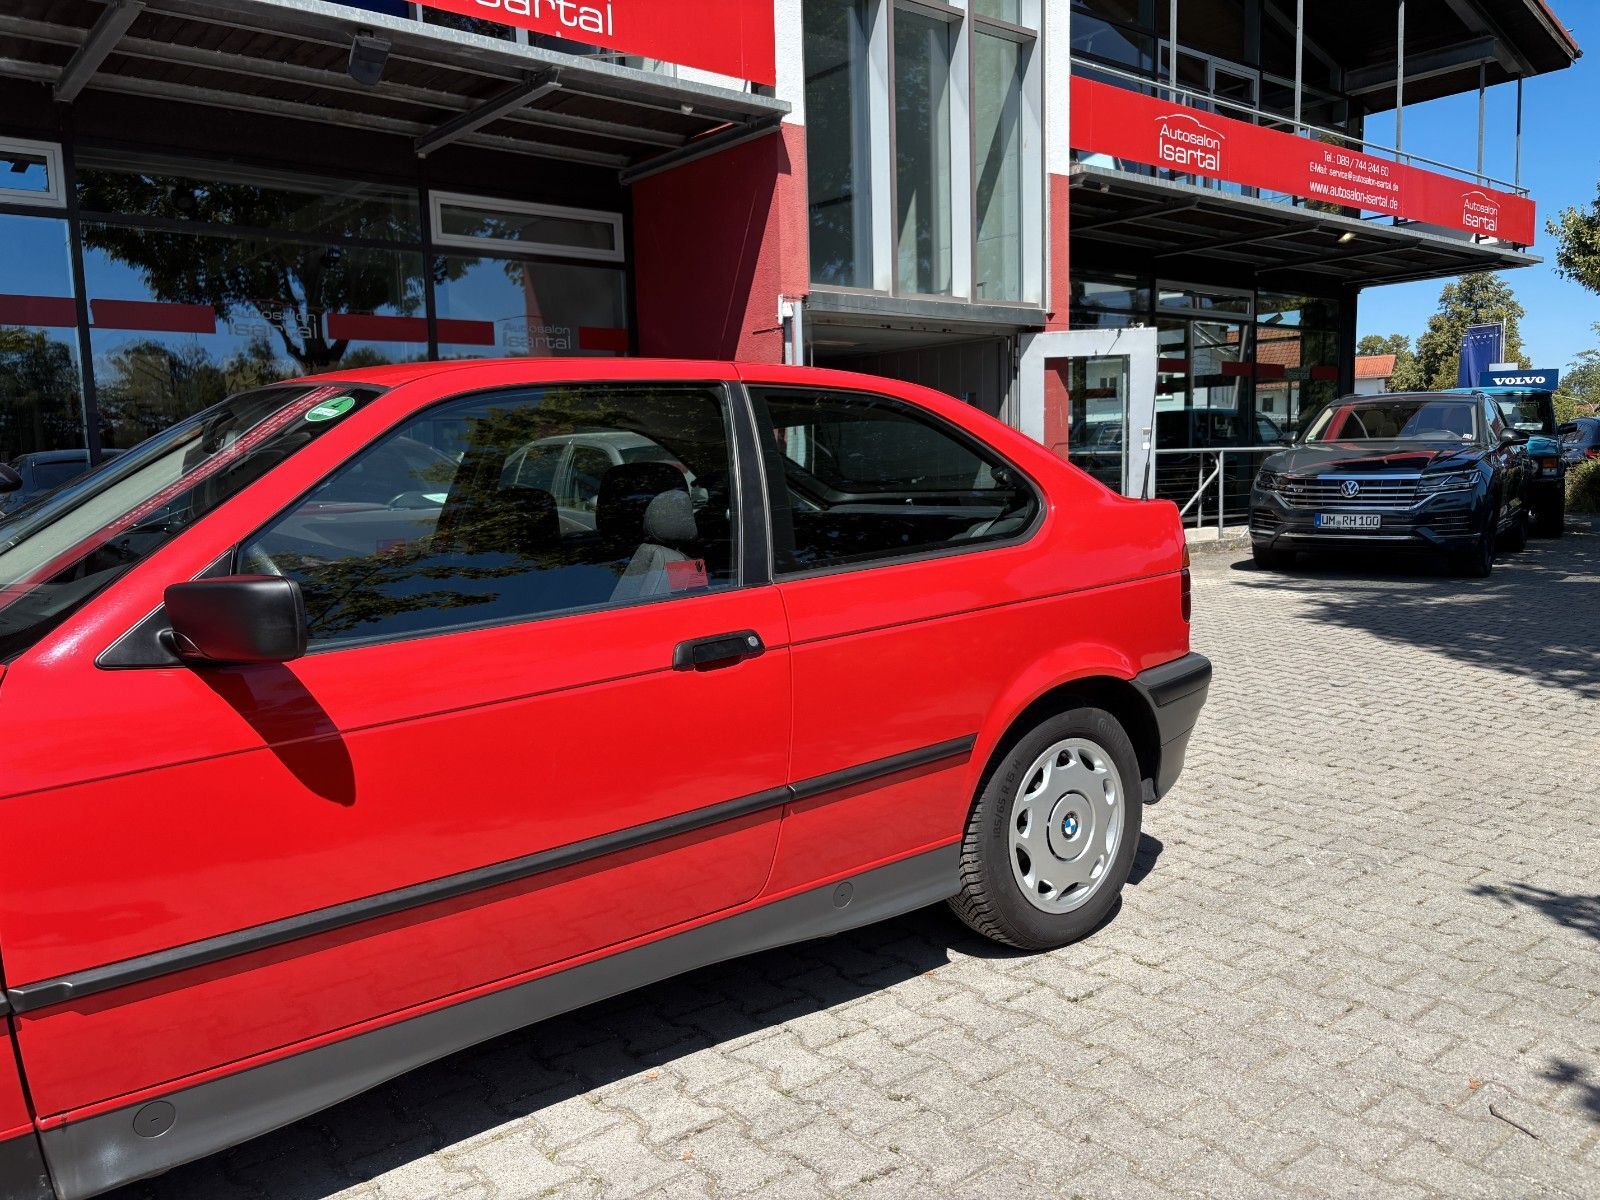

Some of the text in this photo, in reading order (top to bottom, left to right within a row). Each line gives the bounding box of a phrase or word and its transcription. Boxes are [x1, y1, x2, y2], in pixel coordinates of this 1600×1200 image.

[475, 0, 613, 36] artal
[1160, 123, 1220, 150] Autosalon
[1159, 136, 1220, 172] Isartal
[1336, 154, 1350, 167] 089
[1380, 165, 1389, 177] 60
[1309, 181, 1398, 210] www.autosalon-isartal.de
[1464, 199, 1498, 216] Autosalon
[1462, 208, 1498, 232] Isartal
[1493, 376, 1546, 385] VOLVO
[1342, 515, 1357, 526] RH
[1359, 515, 1380, 527] 100
